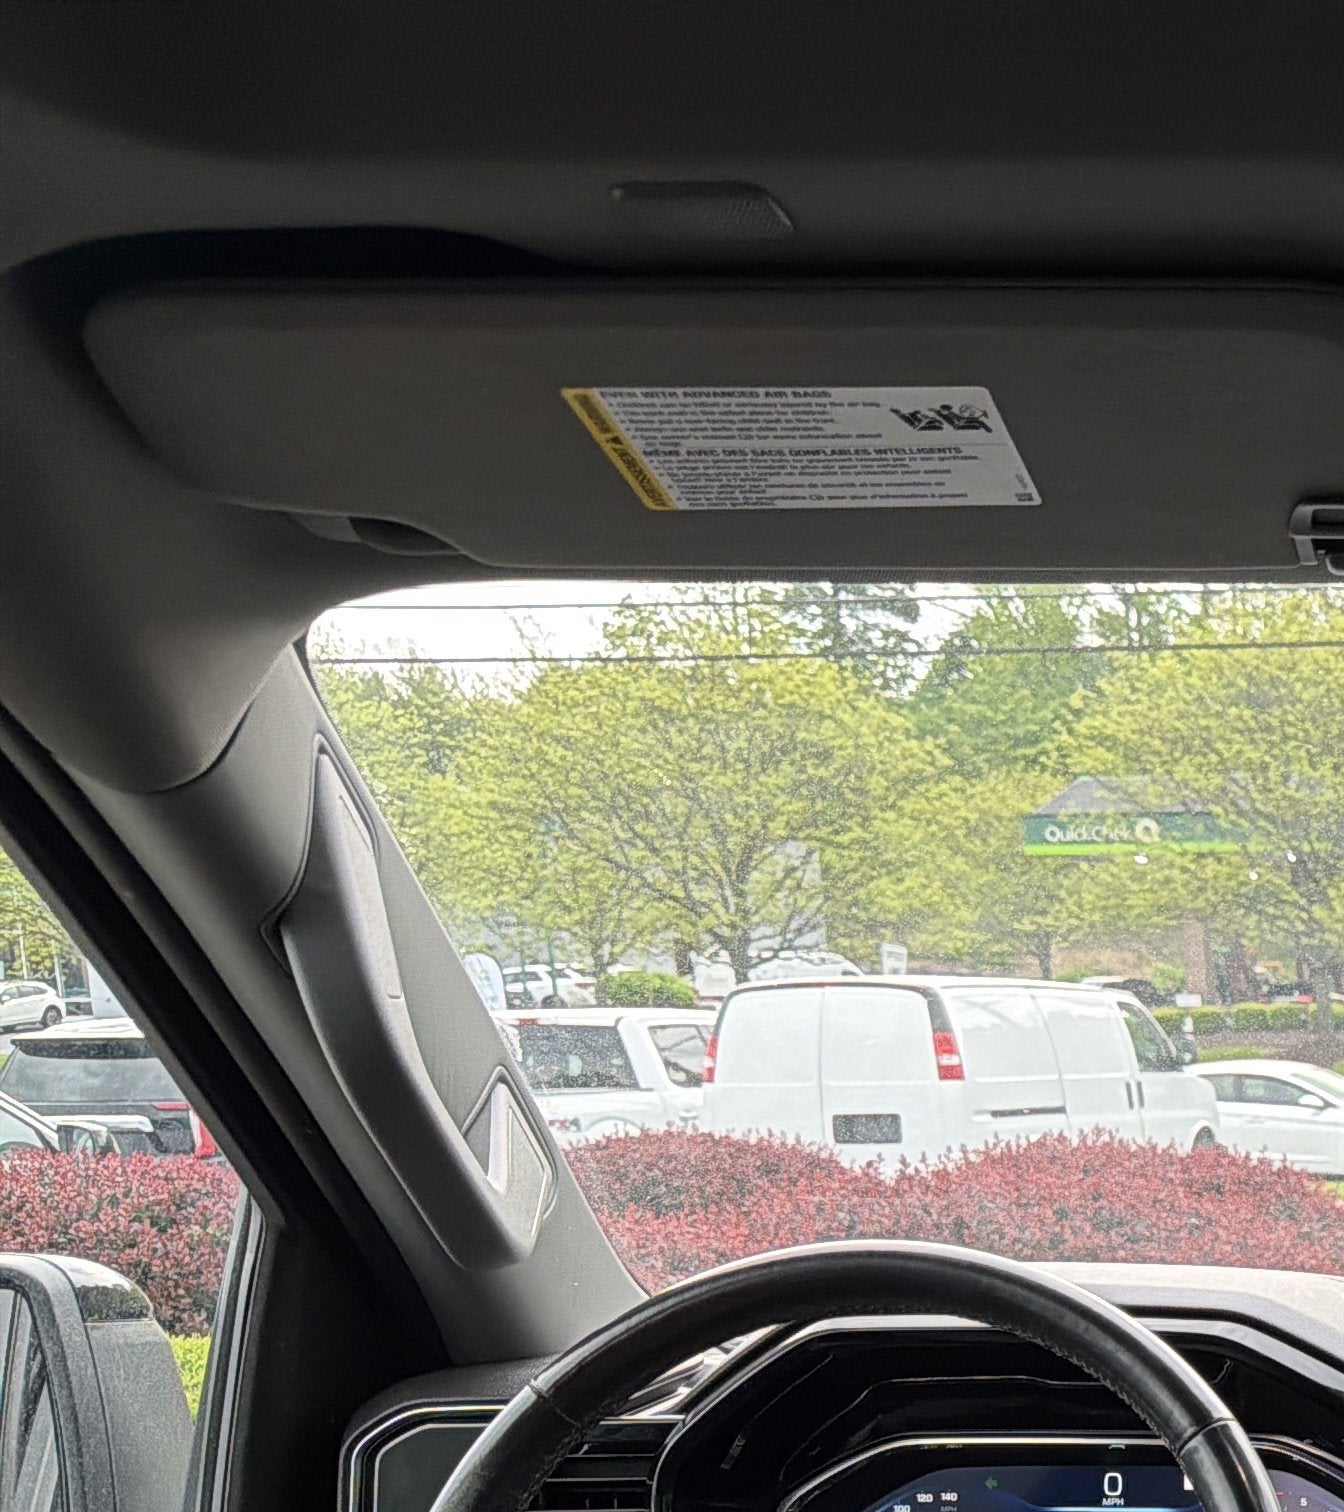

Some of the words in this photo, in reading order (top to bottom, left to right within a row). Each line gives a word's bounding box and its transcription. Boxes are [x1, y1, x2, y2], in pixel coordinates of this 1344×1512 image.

[1103, 1472, 1123, 1496] 0
[916, 1493, 934, 1503] 120
[940, 1492, 958, 1502] 140
[1102, 1497, 1125, 1506] MPH
[1300, 1497, 1308, 1508] 5
